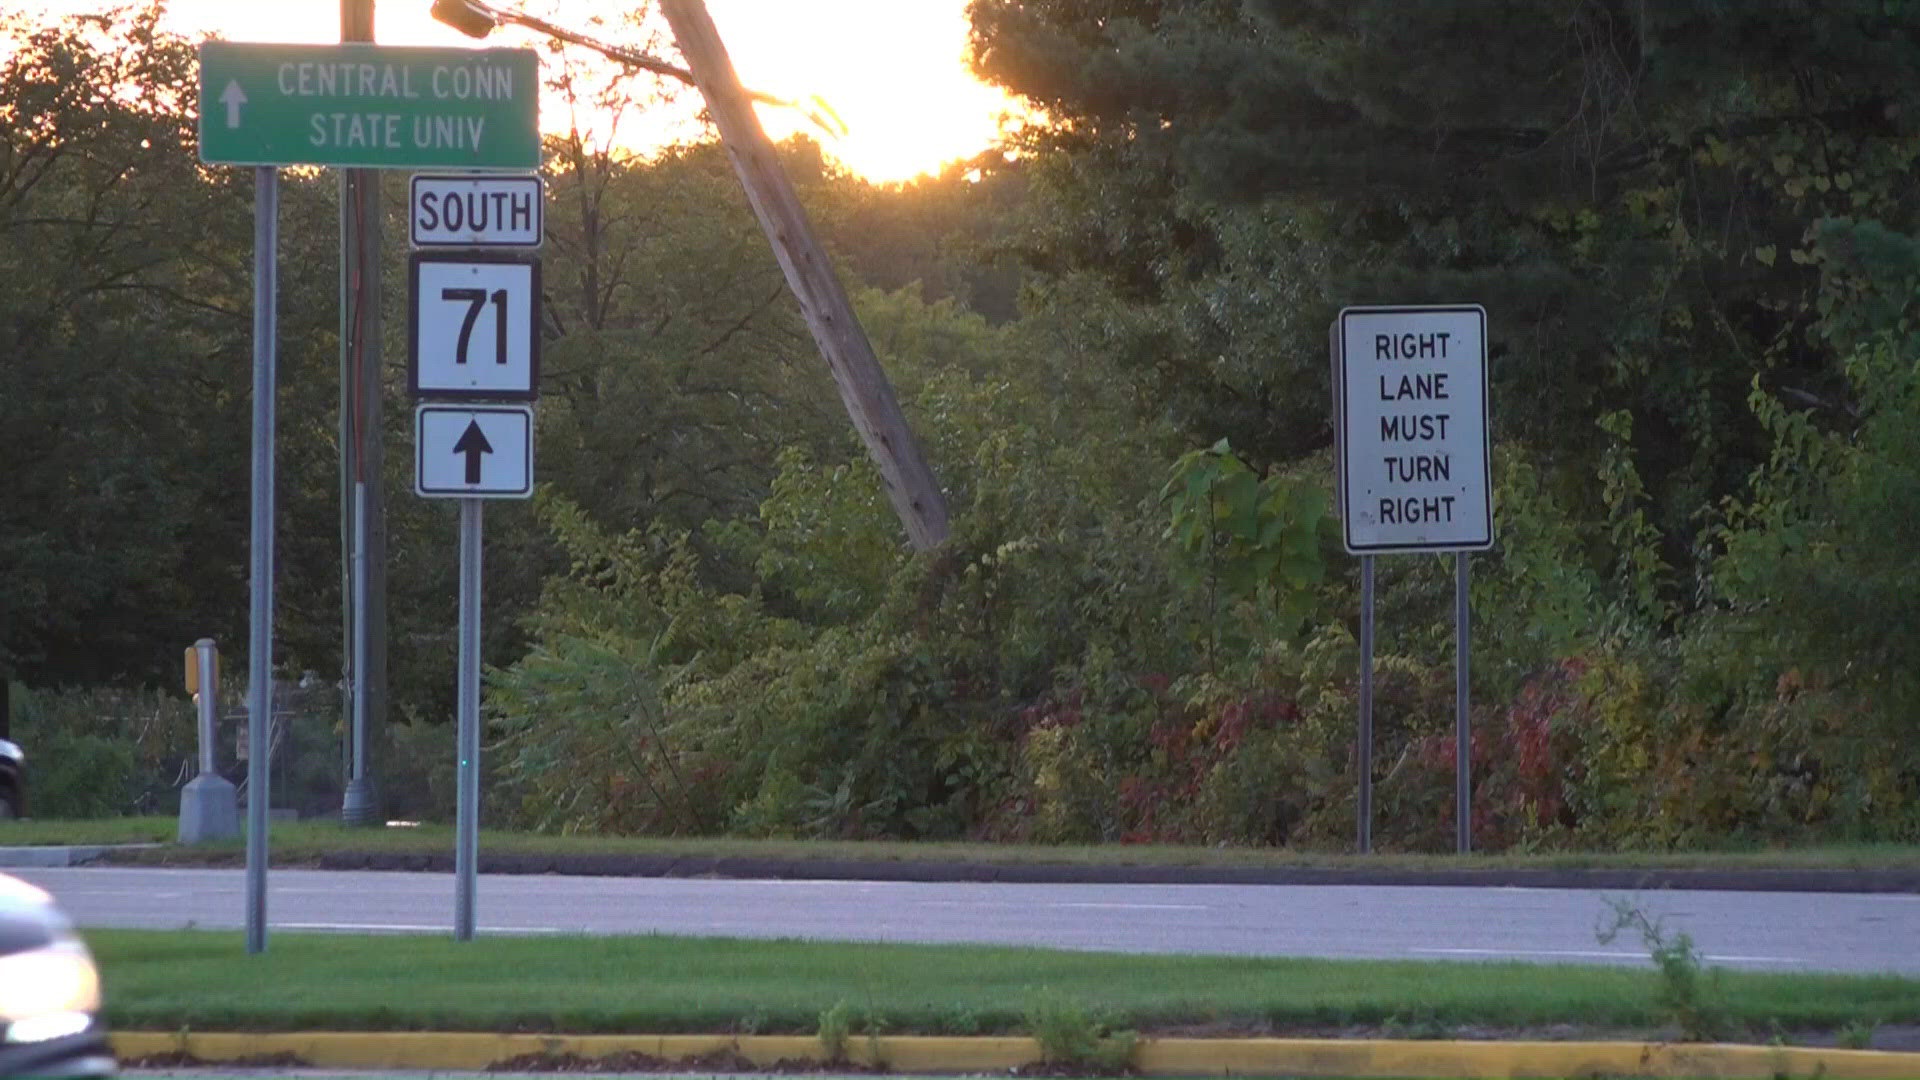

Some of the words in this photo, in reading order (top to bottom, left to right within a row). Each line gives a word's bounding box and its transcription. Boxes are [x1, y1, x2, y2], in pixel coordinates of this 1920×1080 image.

[278, 62, 419, 98] CENTRAL
[432, 65, 513, 100] CONN
[310, 113, 401, 148] STATE
[414, 116, 485, 151] UNIV
[419, 191, 531, 232] SOUTH
[441, 287, 508, 364] 71
[1375, 333, 1451, 360] RIGHT
[1380, 373, 1449, 401] LANE
[1381, 414, 1450, 442] MUST
[1384, 455, 1450, 483] TURN
[1380, 496, 1455, 524] RIGHT
